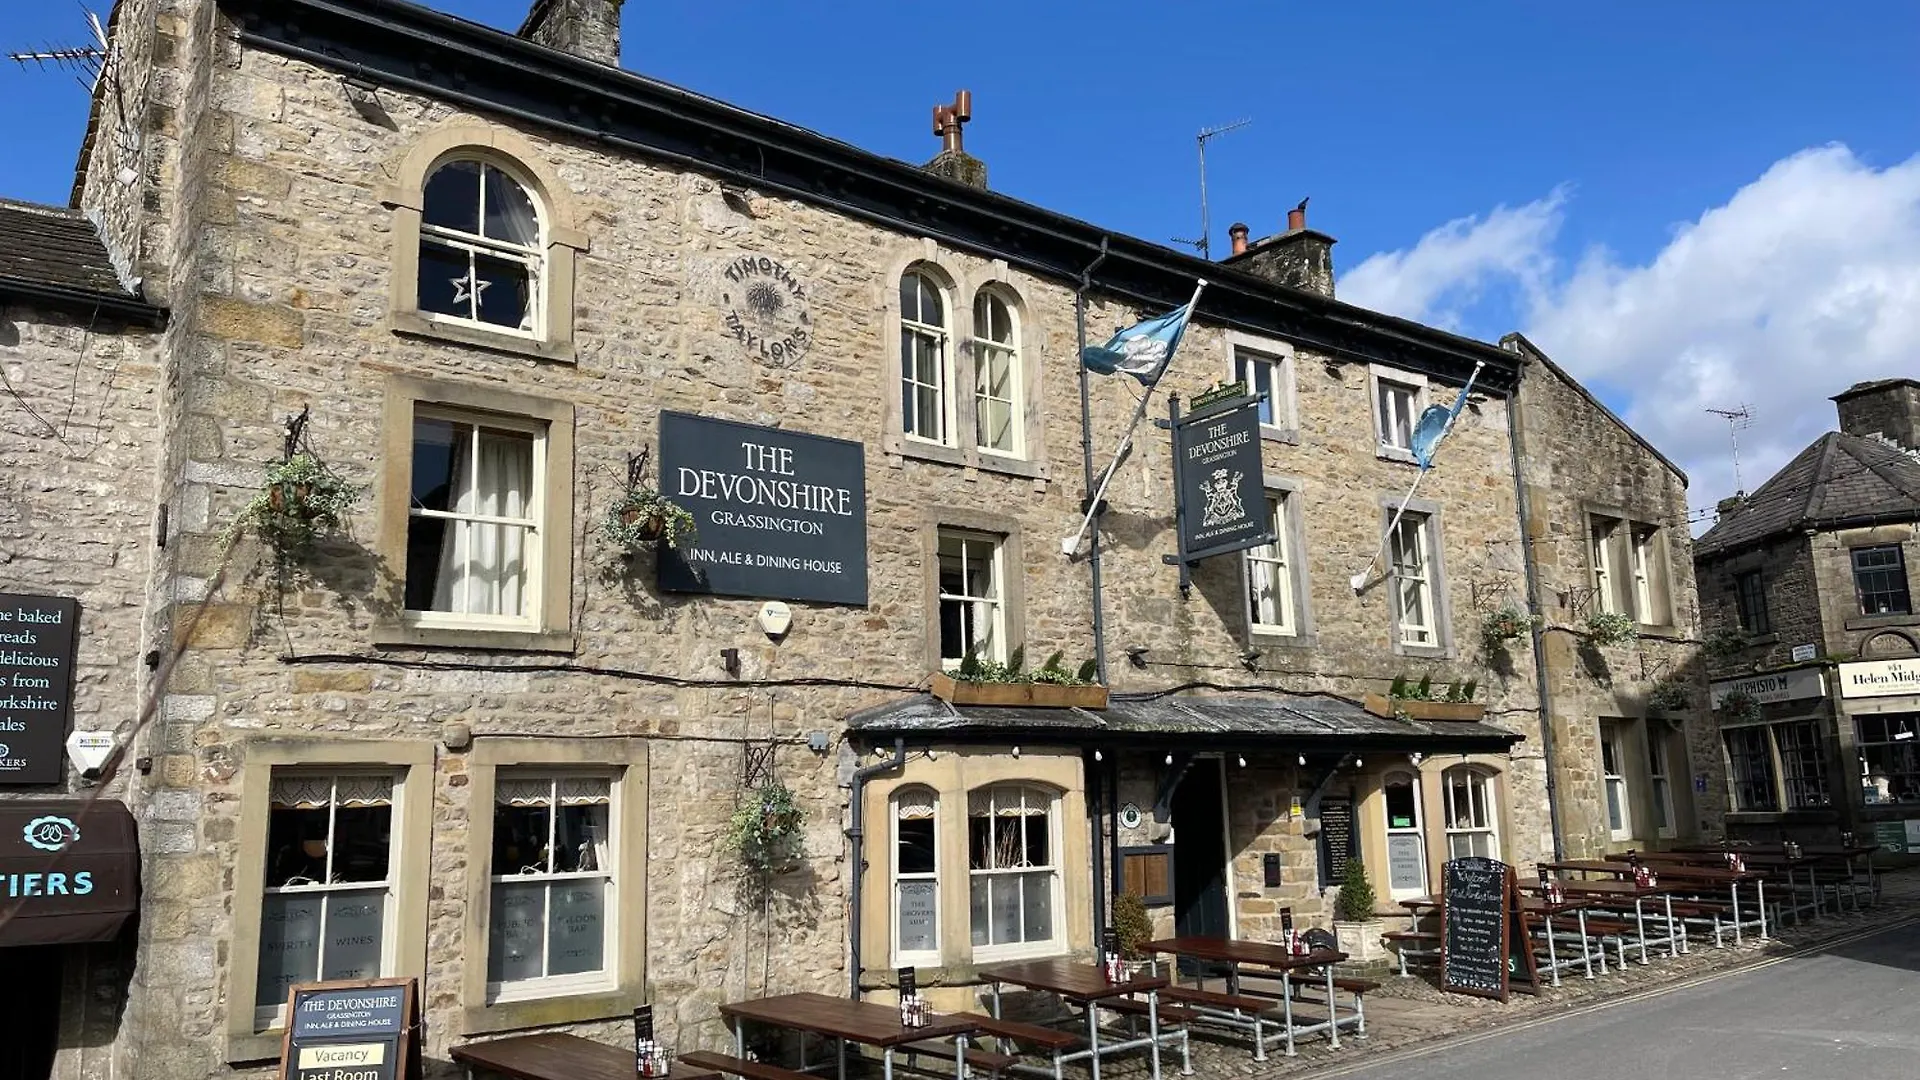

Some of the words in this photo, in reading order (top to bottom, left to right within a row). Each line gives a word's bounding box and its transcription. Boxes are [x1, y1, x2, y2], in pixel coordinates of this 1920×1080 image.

[724, 257, 805, 297] TIMOTHY
[1207, 423, 1228, 439] THE
[1188, 430, 1250, 459] DEVONSHIRE
[742, 442, 795, 476] THE
[678, 467, 852, 516] DEVONSHIRE
[710, 510, 823, 535] GRASSINGTON
[690, 548, 717, 564] INN,
[720, 552, 742, 565] ALE
[745, 554, 753, 566] &
[756, 555, 800, 570] DINING
[803, 559, 842, 574] HOUSE
[18, 608, 62, 624] baked
[13, 672, 50, 688] from
[1853, 673, 1888, 685] Helen
[0, 695, 58, 711] rkshire
[0, 871, 93, 897] IERS
[336, 935, 374, 946] WINES
[303, 1001, 325, 1012] THE
[328, 996, 398, 1011] DEVONSHIRE
[326, 1011, 372, 1020] GRASSINGTON
[341, 1020, 367, 1028] DINING
[368, 1018, 392, 1026] HOUSE
[315, 1049, 369, 1062] Vacancy
